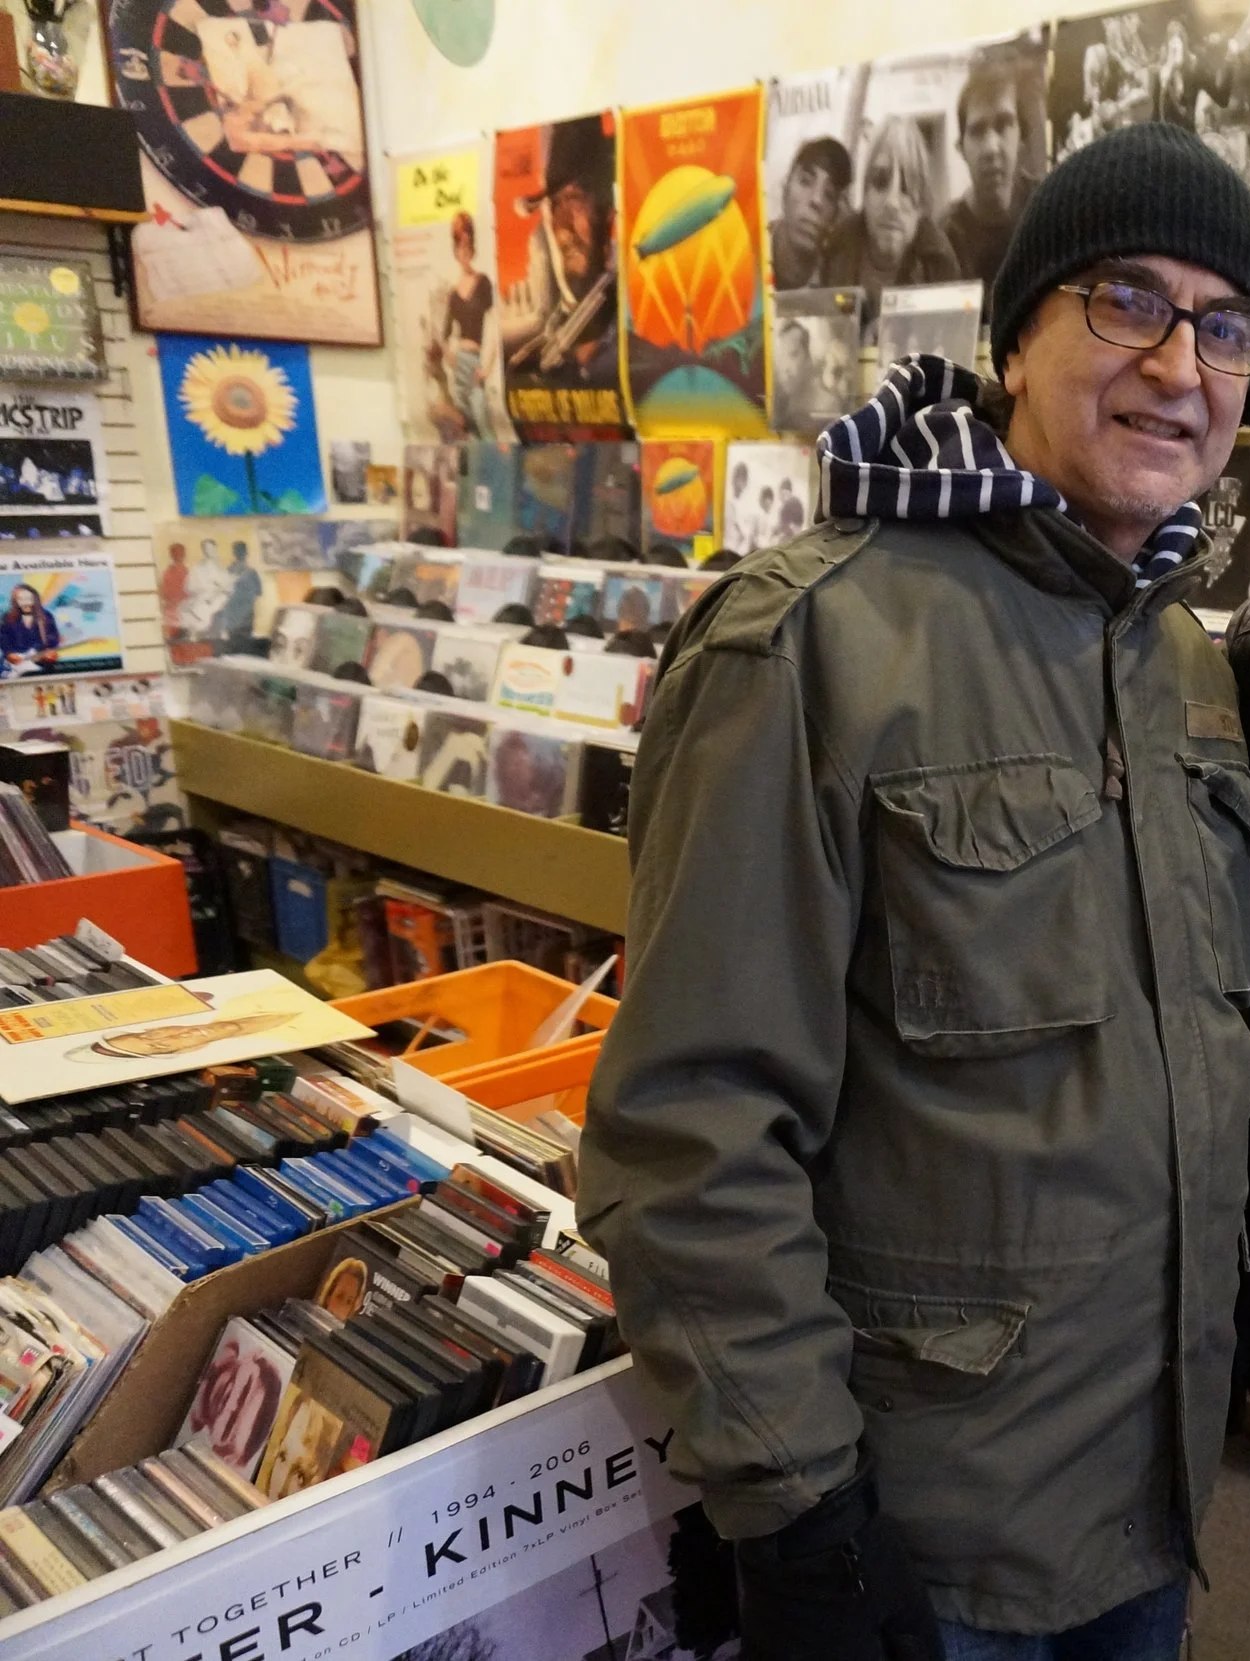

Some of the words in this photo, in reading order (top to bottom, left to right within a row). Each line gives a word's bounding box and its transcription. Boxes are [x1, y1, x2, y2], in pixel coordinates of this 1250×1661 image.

[171, 1550, 362, 1644] TOGETHER
[431, 1484, 496, 1523] 1994
[529, 1440, 591, 1480] 2006
[424, 1427, 675, 1578] KINNEY
[338, 1632, 361, 1647] CD
[377, 1613, 396, 1628] LP
[412, 1577, 465, 1609] Limited
[470, 1552, 517, 1579] Edition
[560, 1514, 590, 1534] Vinyl
